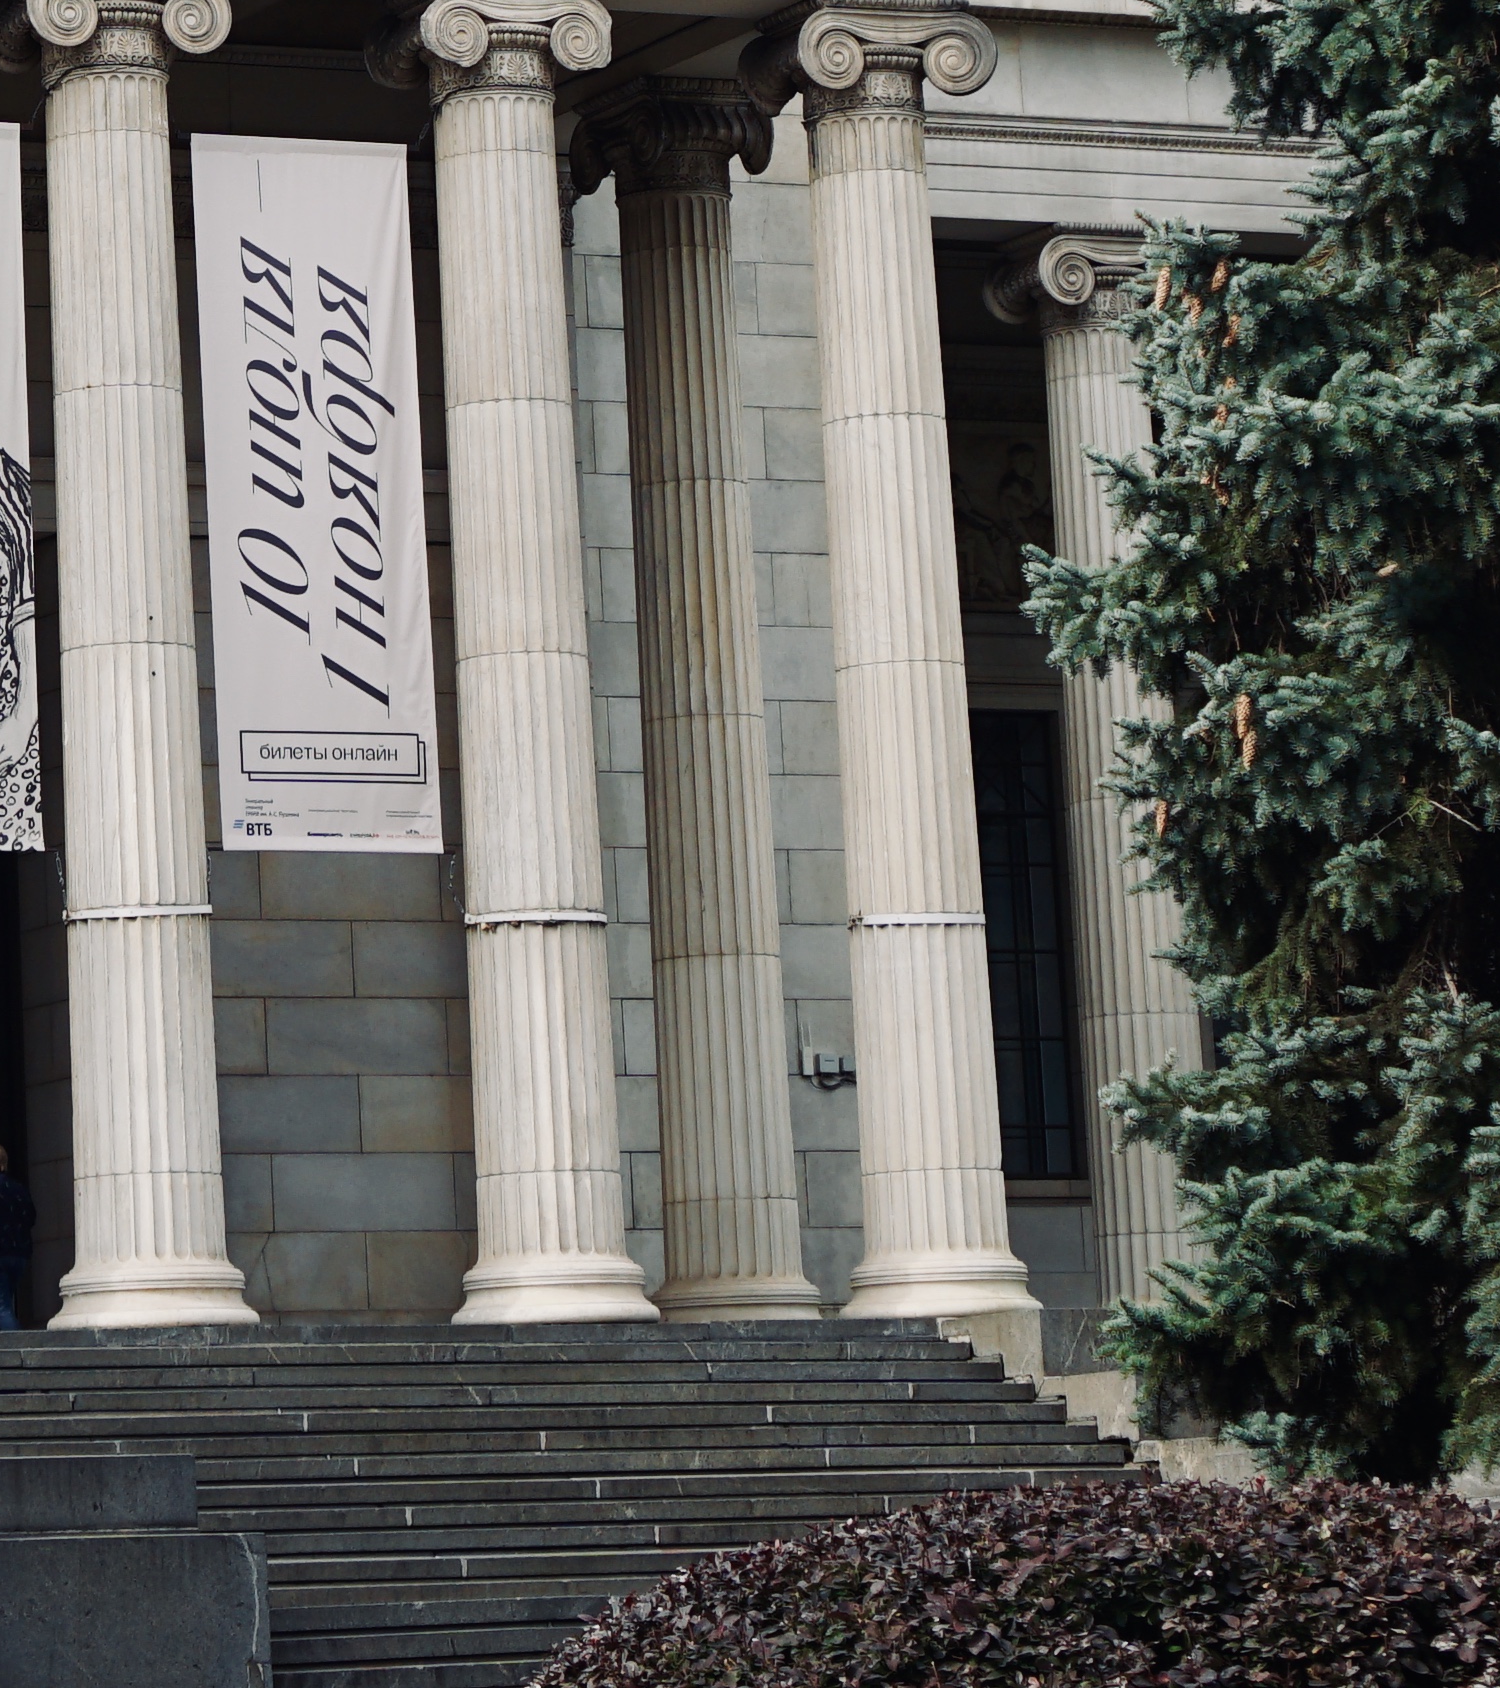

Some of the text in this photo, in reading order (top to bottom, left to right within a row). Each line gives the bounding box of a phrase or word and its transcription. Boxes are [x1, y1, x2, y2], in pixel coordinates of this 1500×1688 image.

[239, 235, 306, 509] июля
[301, 265, 395, 649] ноября
[237, 527, 311, 646] 10
[320, 653, 391, 719] 1
[259, 743, 398, 761] билеты онлайн
[246, 823, 273, 836] ВТБ
